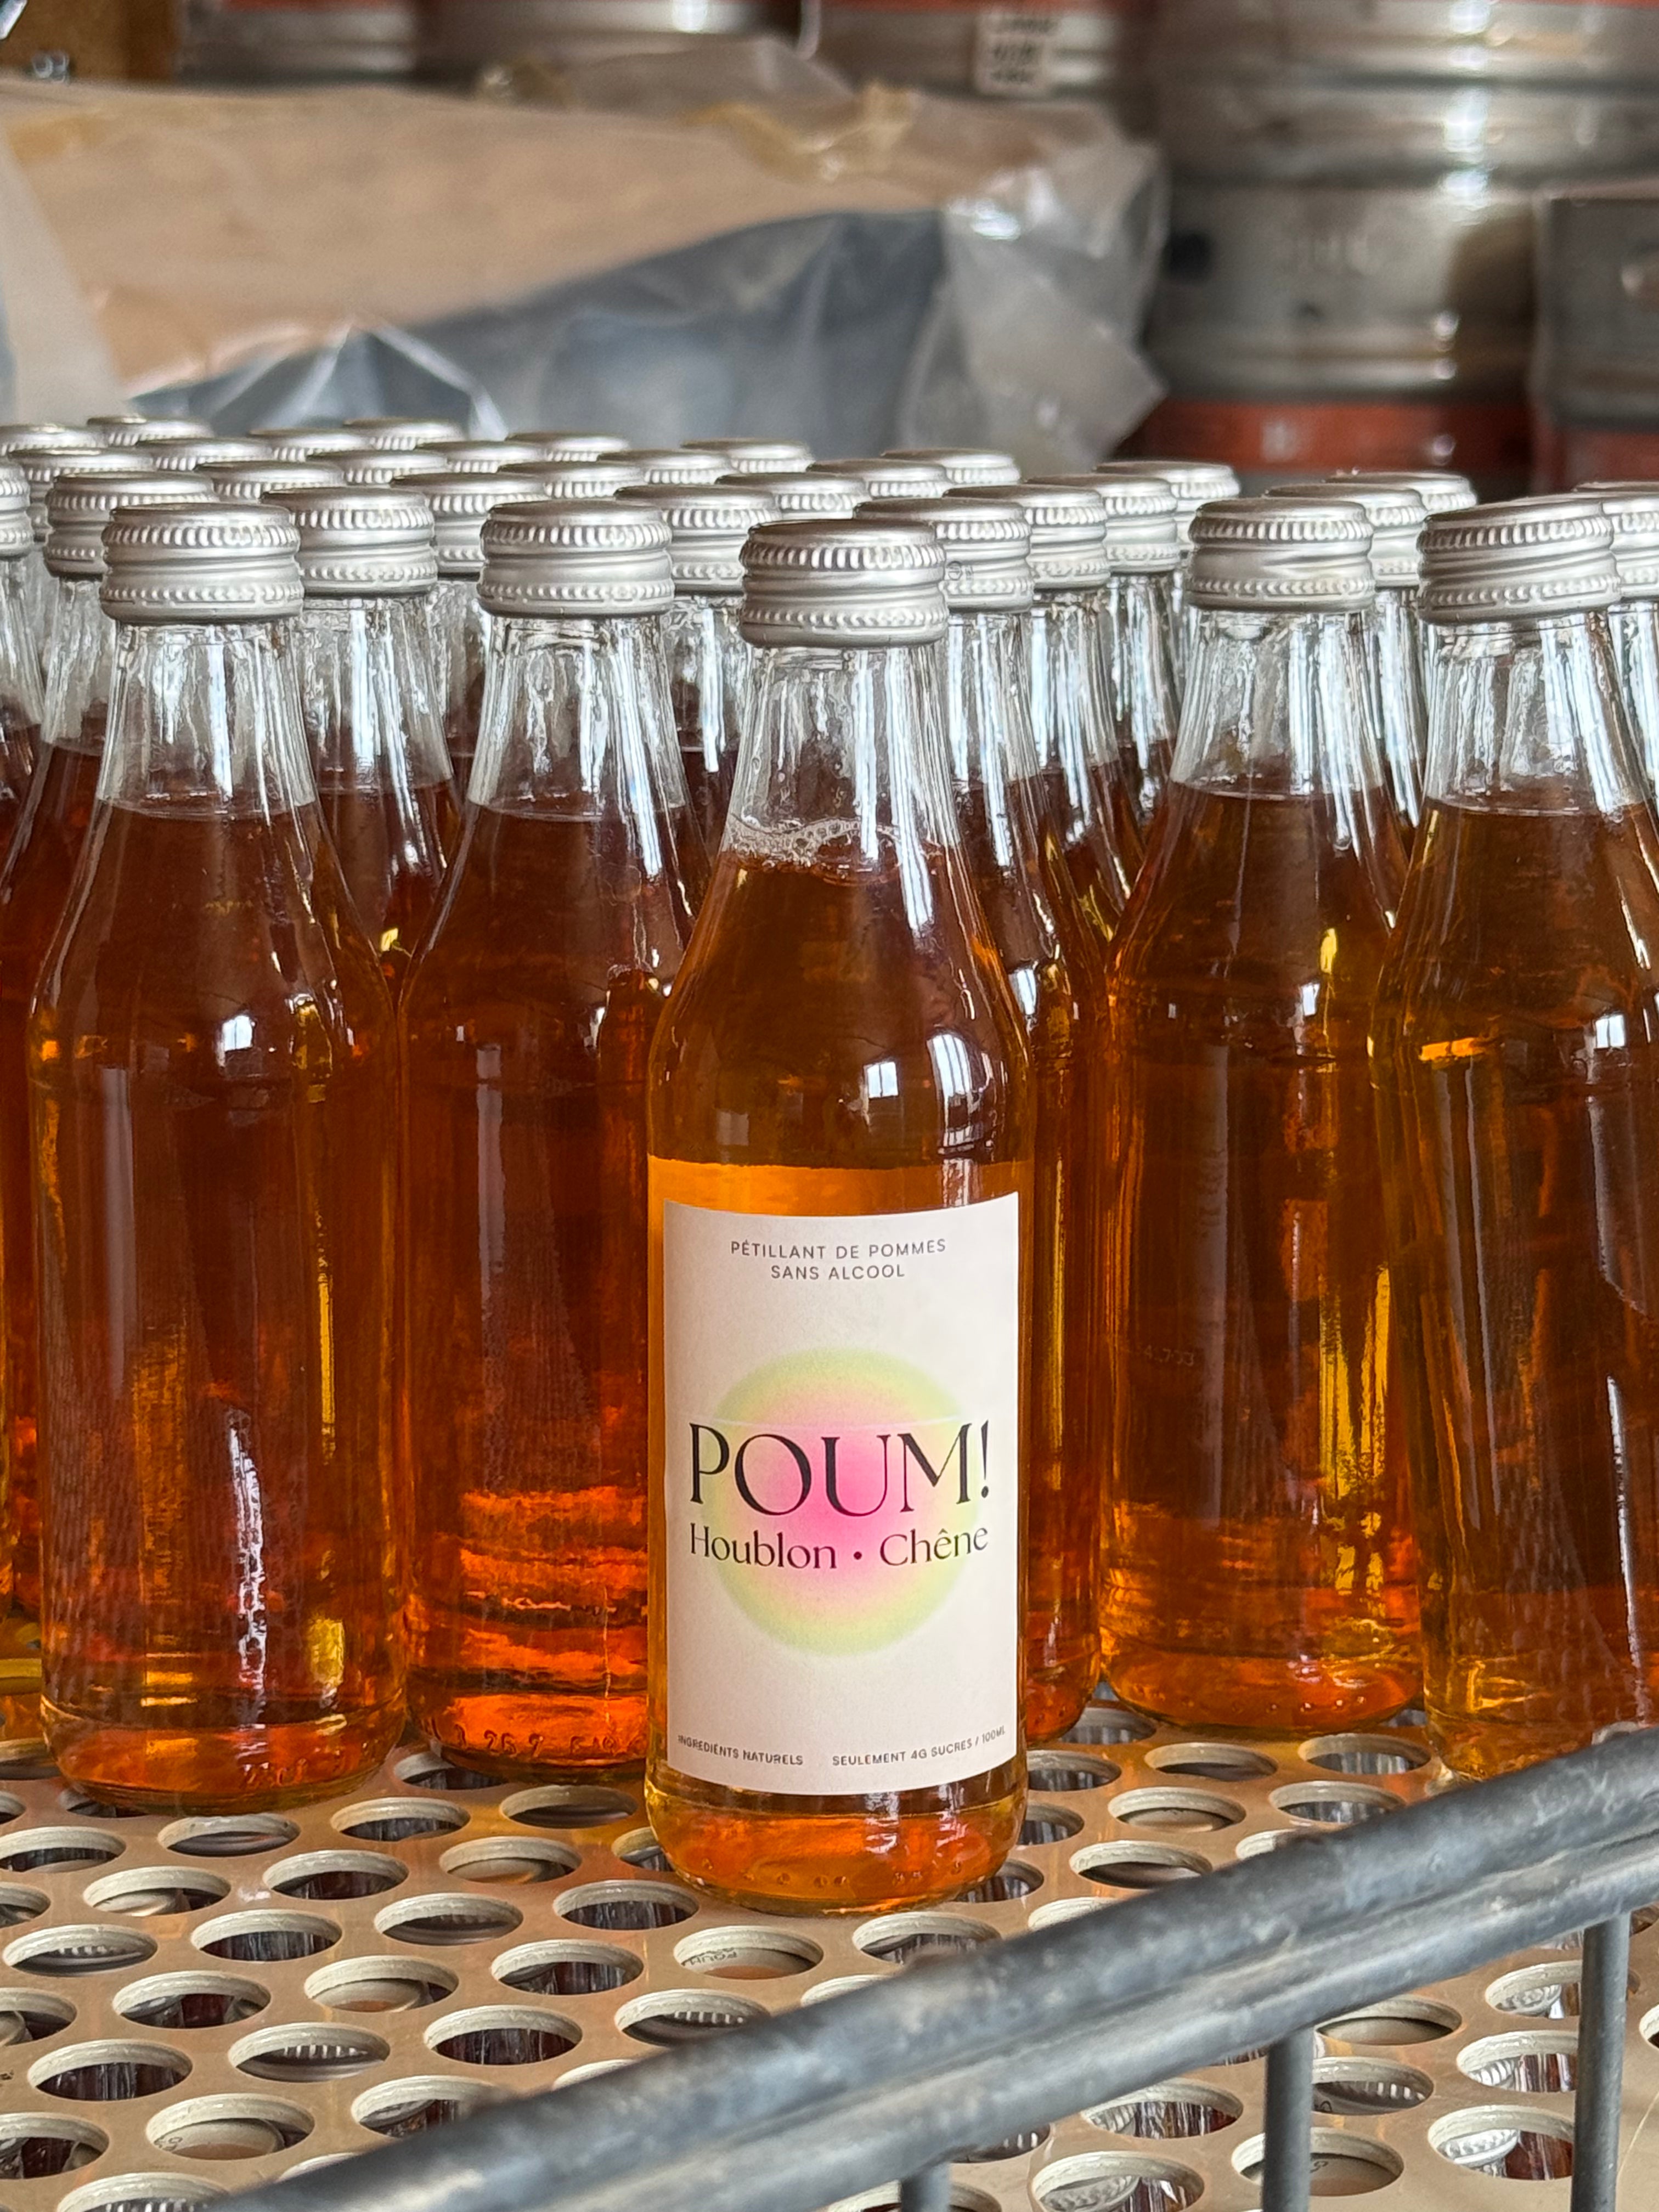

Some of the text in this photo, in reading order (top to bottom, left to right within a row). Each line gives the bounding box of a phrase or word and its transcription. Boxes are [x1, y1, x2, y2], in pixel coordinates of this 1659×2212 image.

[730, 1238, 946, 1260] PÉTILLANT DE POMMES
[771, 1263, 905, 1280] SANS ALCOOL
[689, 1420, 989, 1517] POUM!
[690, 1523, 989, 1569] Houblon Chêne
[743, 1749, 803, 1765] NATURELS
[832, 1751, 906, 1766] SEULEMENT
[910, 1748, 927, 1760] 4G
[931, 1737, 972, 1757] SUCRES
